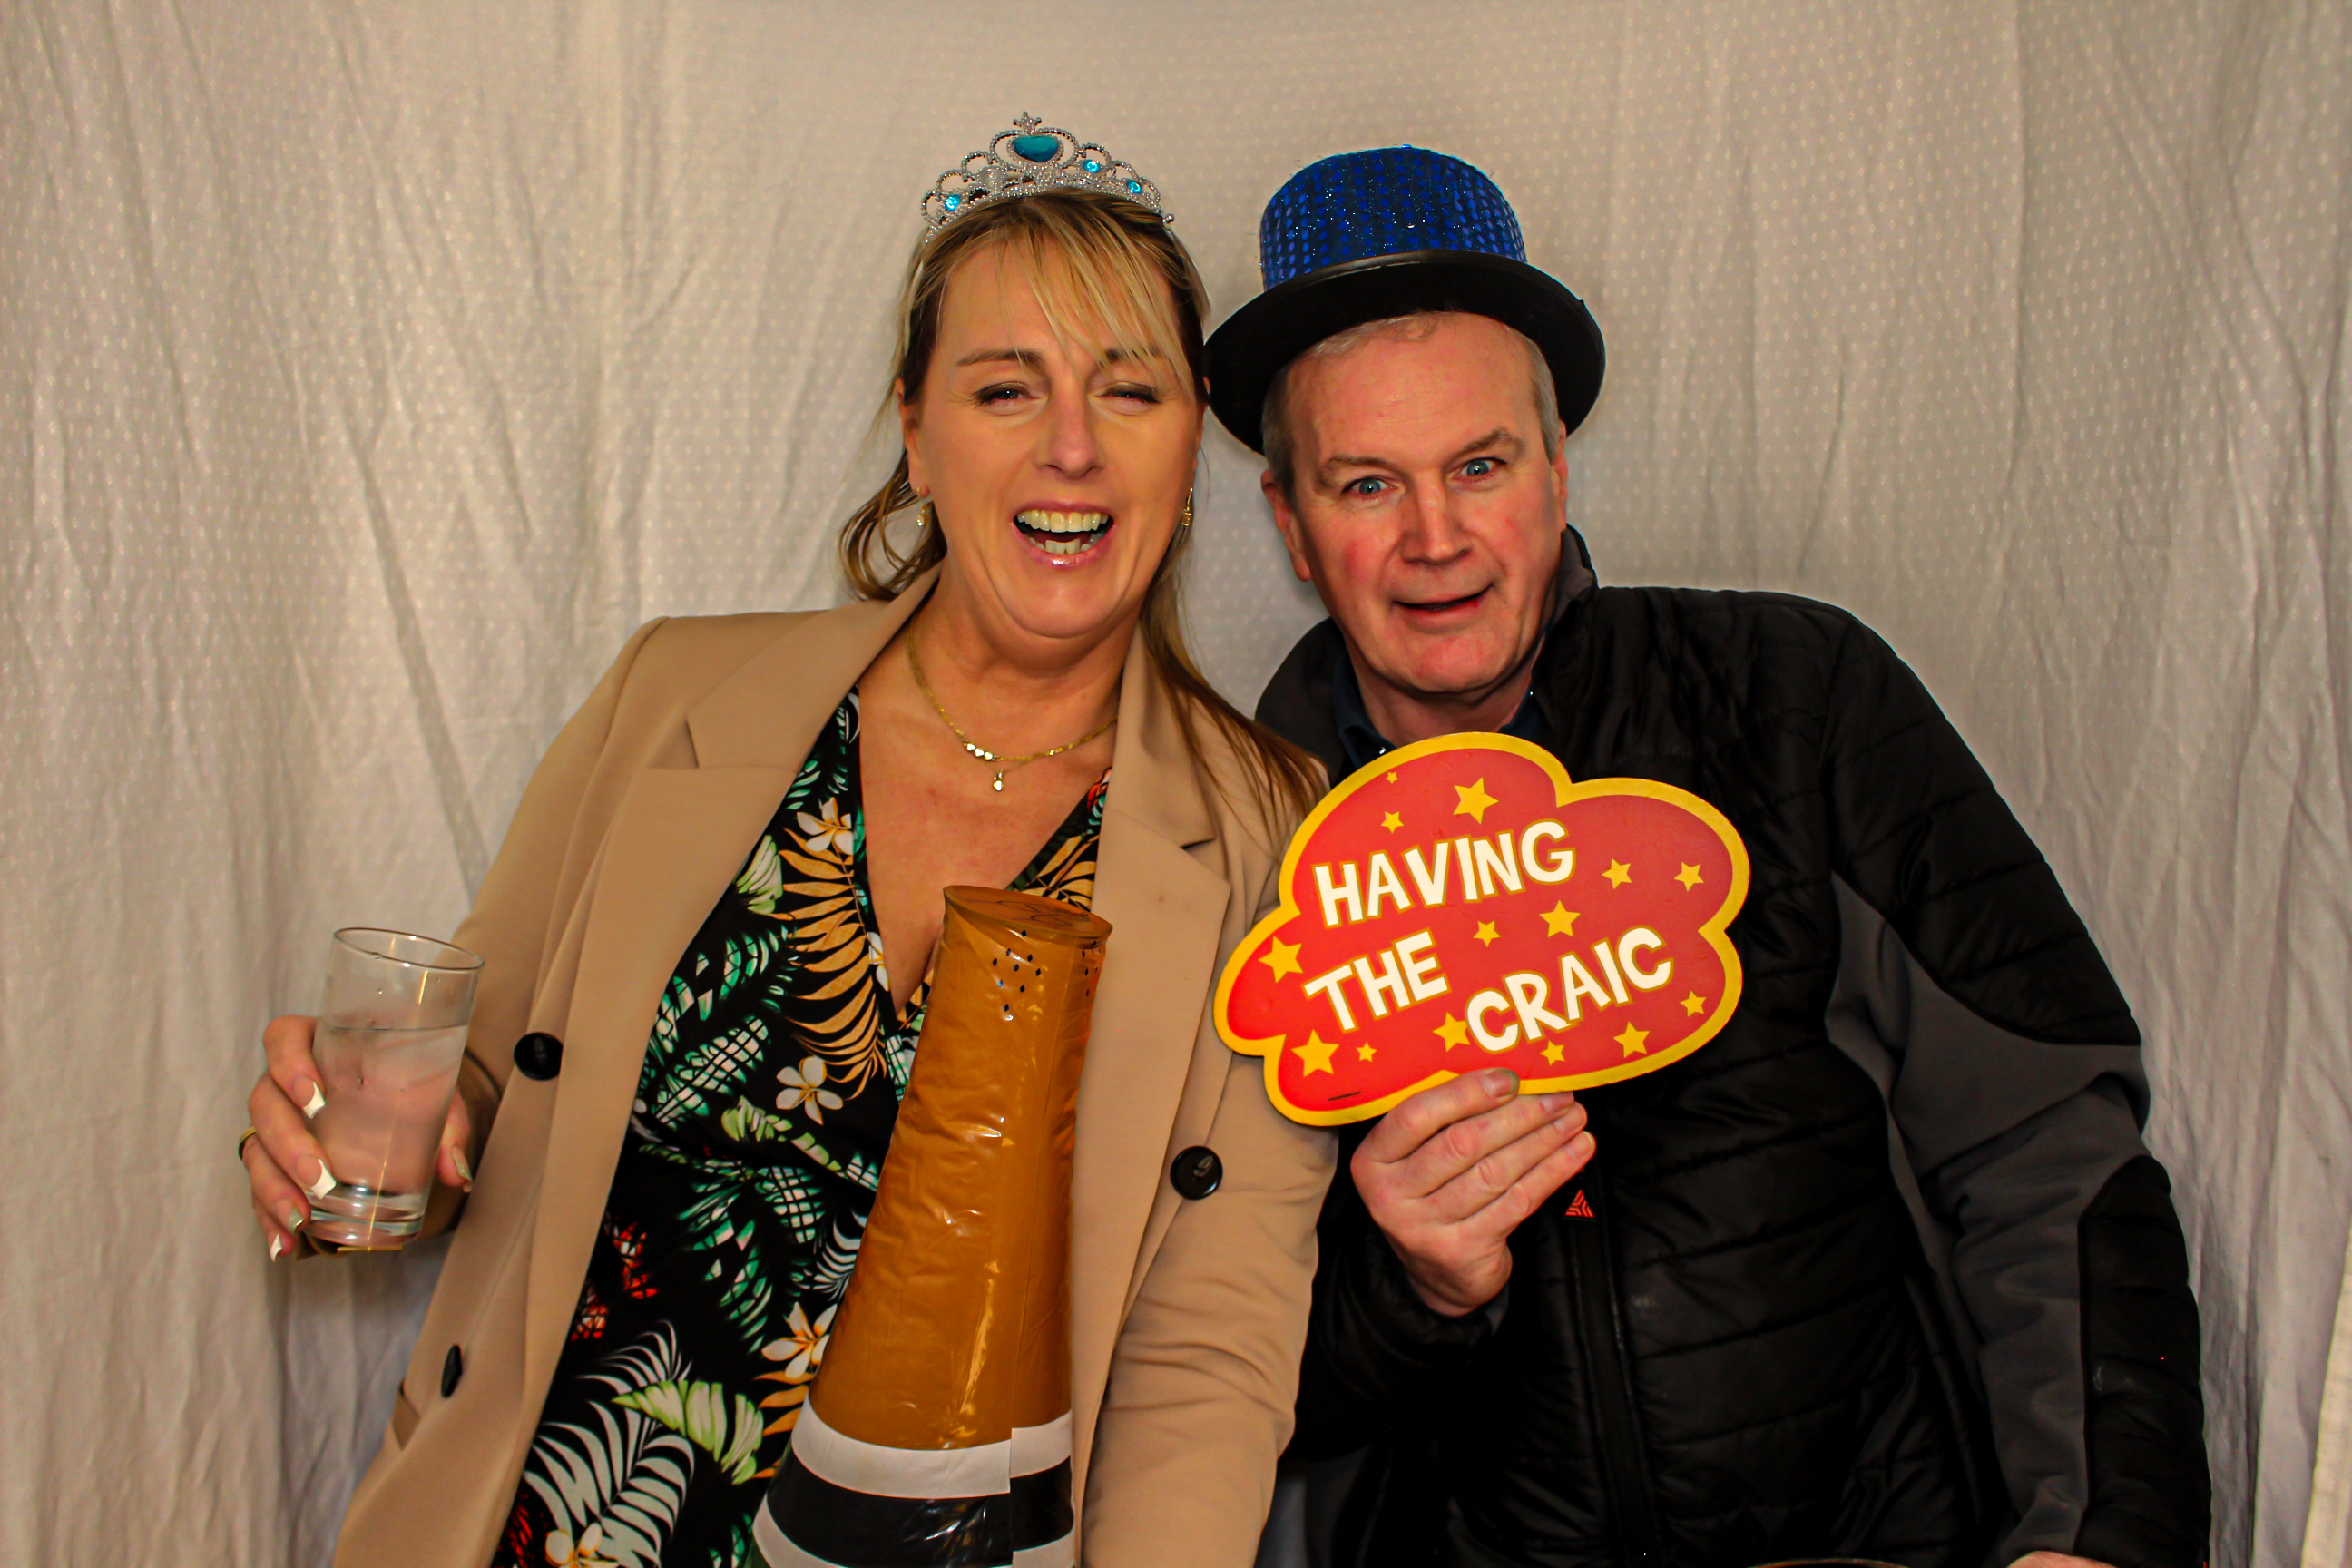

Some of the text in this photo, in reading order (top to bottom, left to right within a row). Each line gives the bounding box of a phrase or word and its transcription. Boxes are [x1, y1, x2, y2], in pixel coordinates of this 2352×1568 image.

[1314, 819, 1574, 926] HAVING
[1304, 930, 1448, 1032] THE
[1466, 926, 1672, 1053] CRAIC
